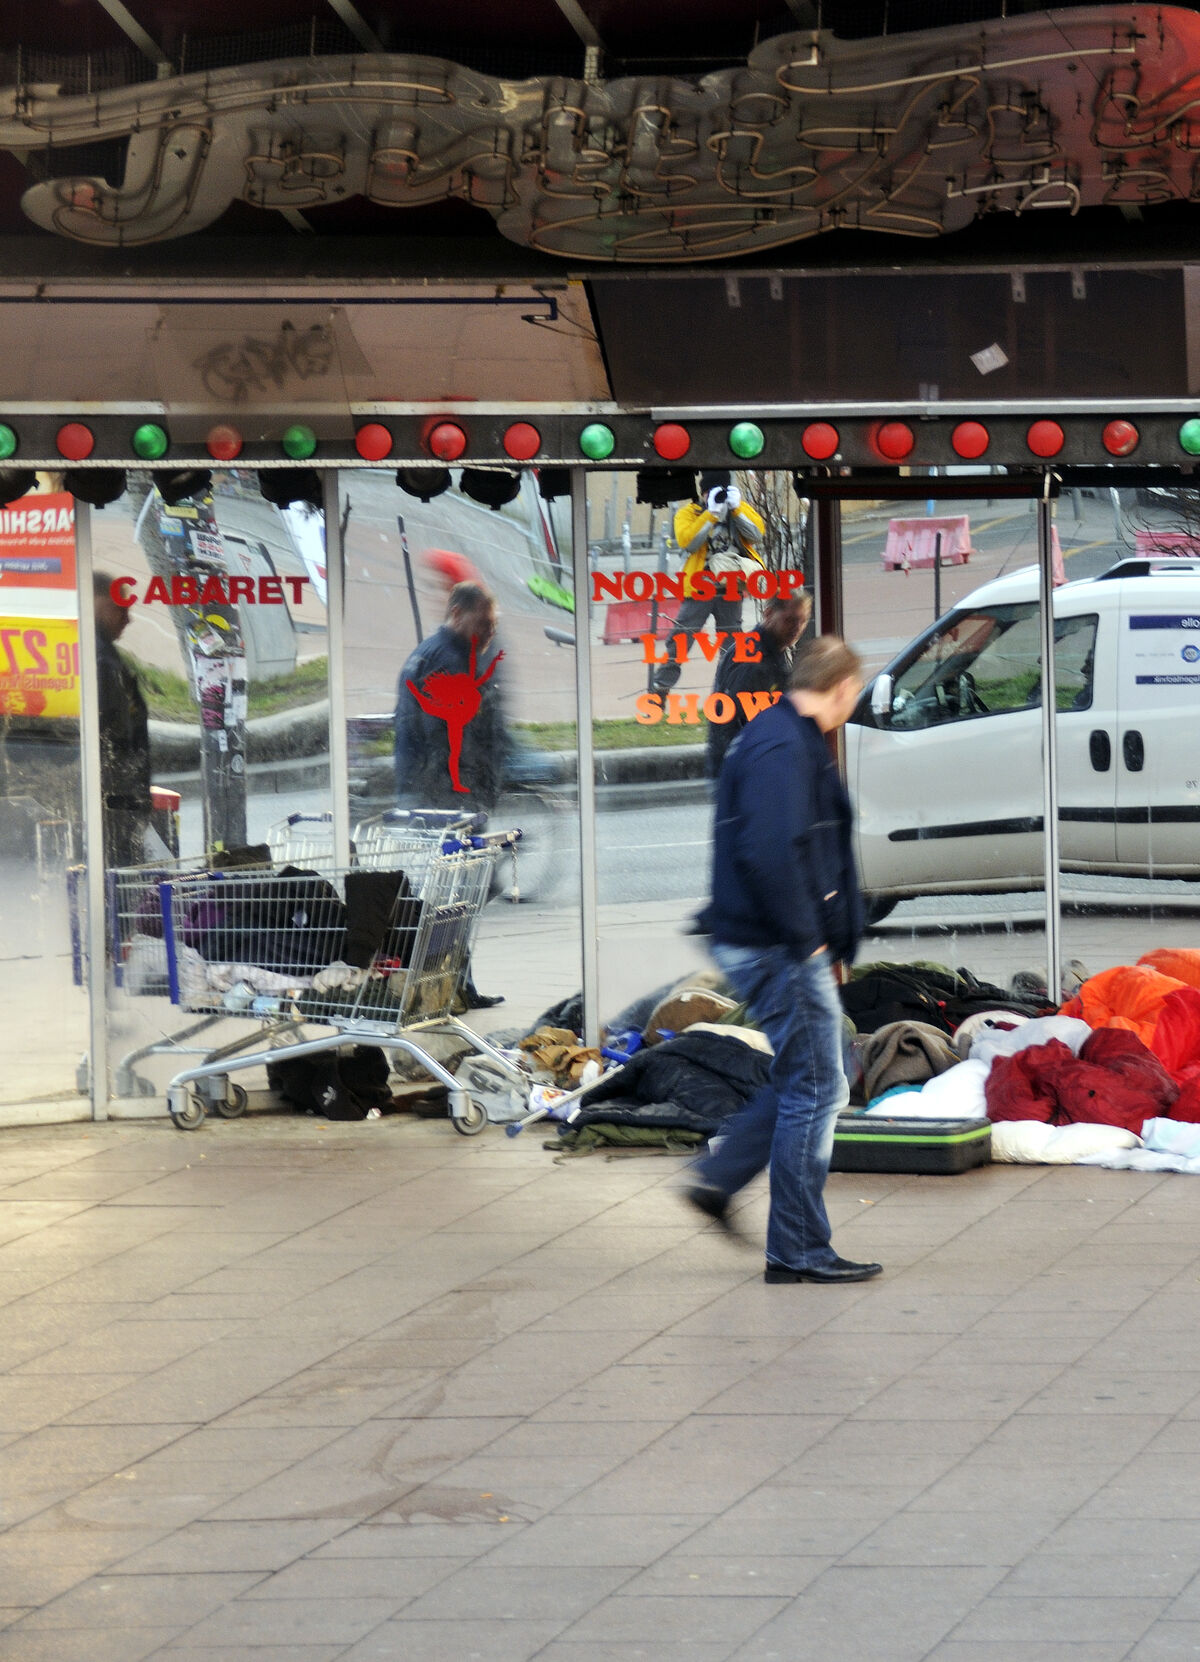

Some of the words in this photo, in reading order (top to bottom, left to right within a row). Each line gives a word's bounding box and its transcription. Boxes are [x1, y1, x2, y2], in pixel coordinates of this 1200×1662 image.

[110, 576, 310, 607] CABARET
[591, 569, 805, 601] NONSTOP
[640, 632, 763, 664] LIVE
[636, 691, 783, 725] SHOW
